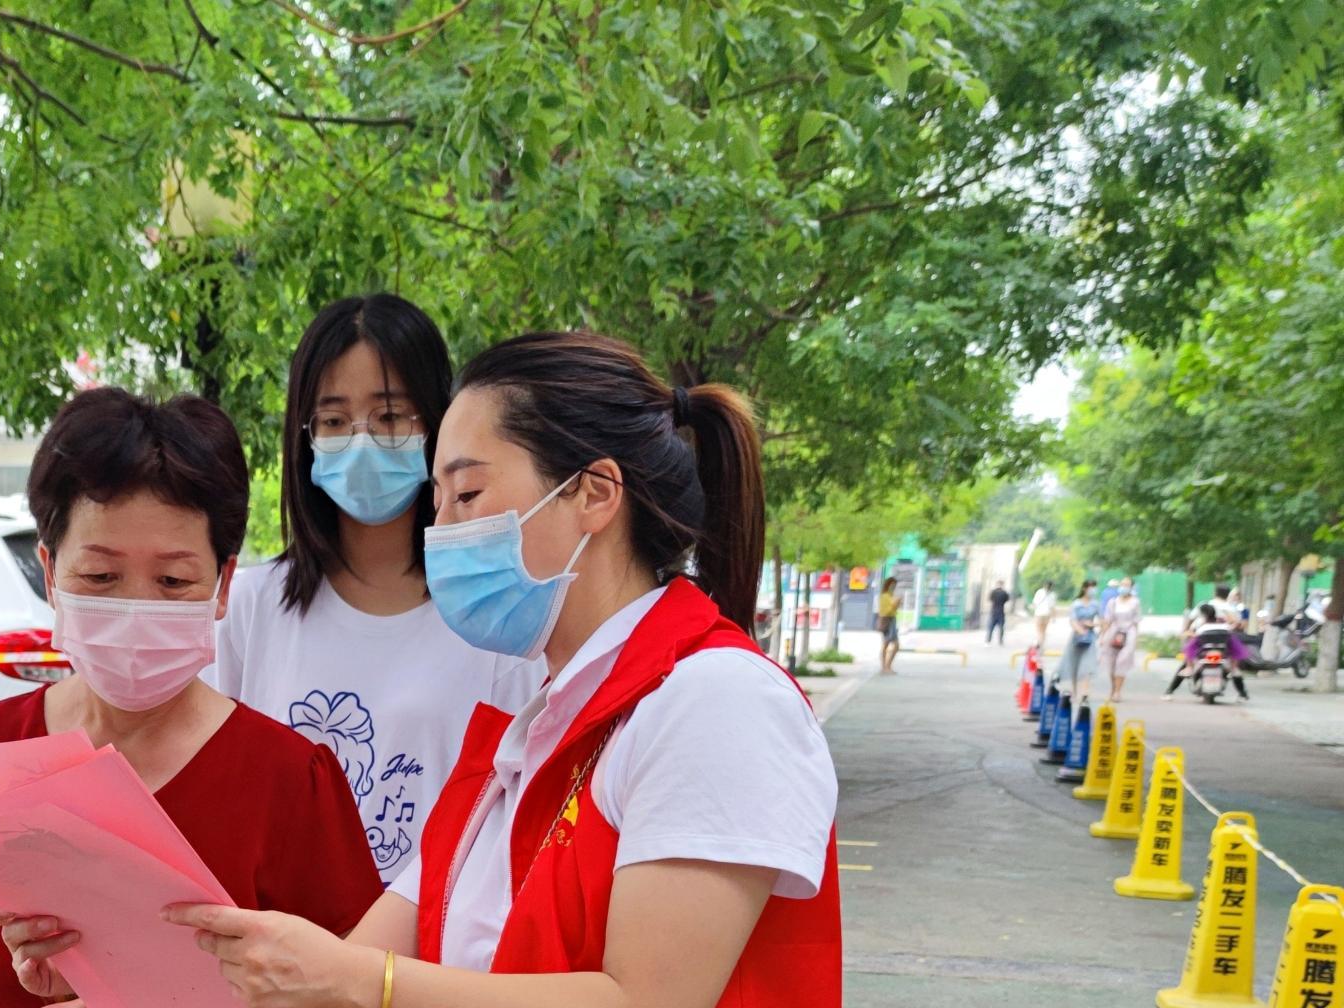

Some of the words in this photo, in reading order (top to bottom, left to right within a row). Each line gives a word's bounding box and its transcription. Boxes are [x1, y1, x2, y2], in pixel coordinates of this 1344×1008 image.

[1213, 866, 1248, 976] 腾发二手车
